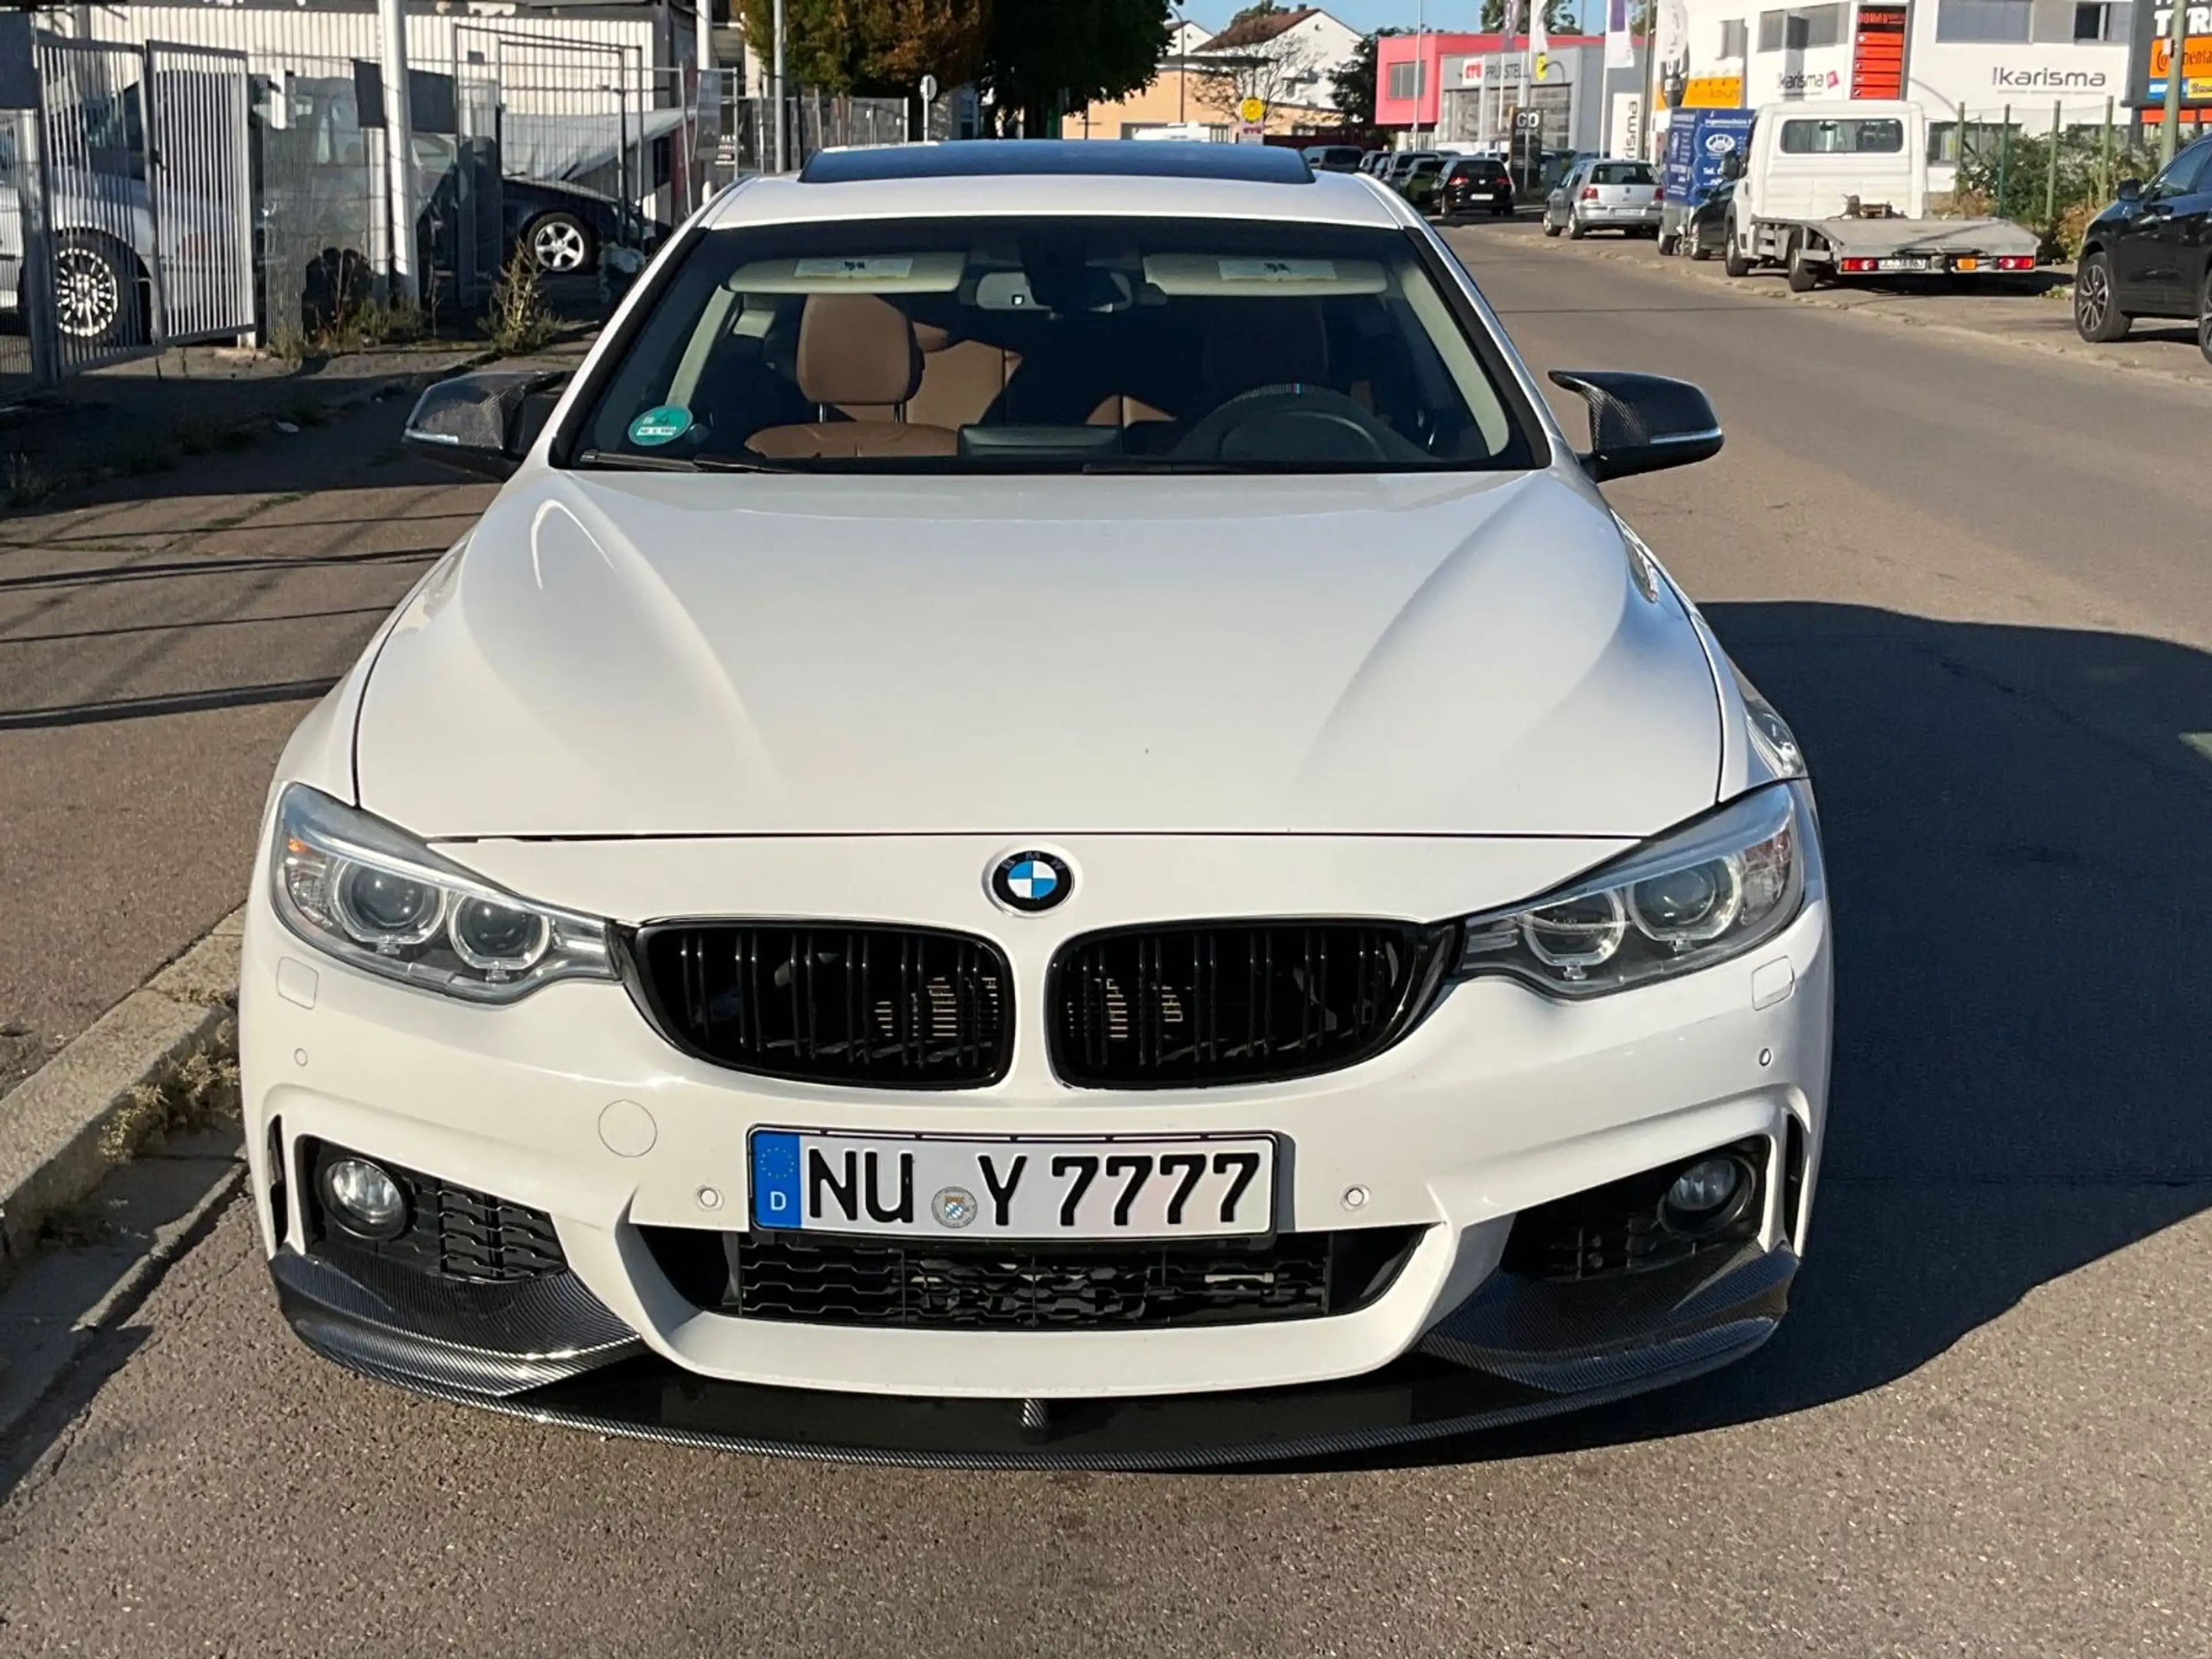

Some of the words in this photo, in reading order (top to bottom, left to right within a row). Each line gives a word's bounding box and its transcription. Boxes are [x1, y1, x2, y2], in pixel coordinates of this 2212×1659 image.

[771, 1191, 786, 1211] D
[808, 1148, 914, 1224] NU
[978, 1155, 1028, 1226] Y
[1052, 1153, 1260, 1226] 7777
